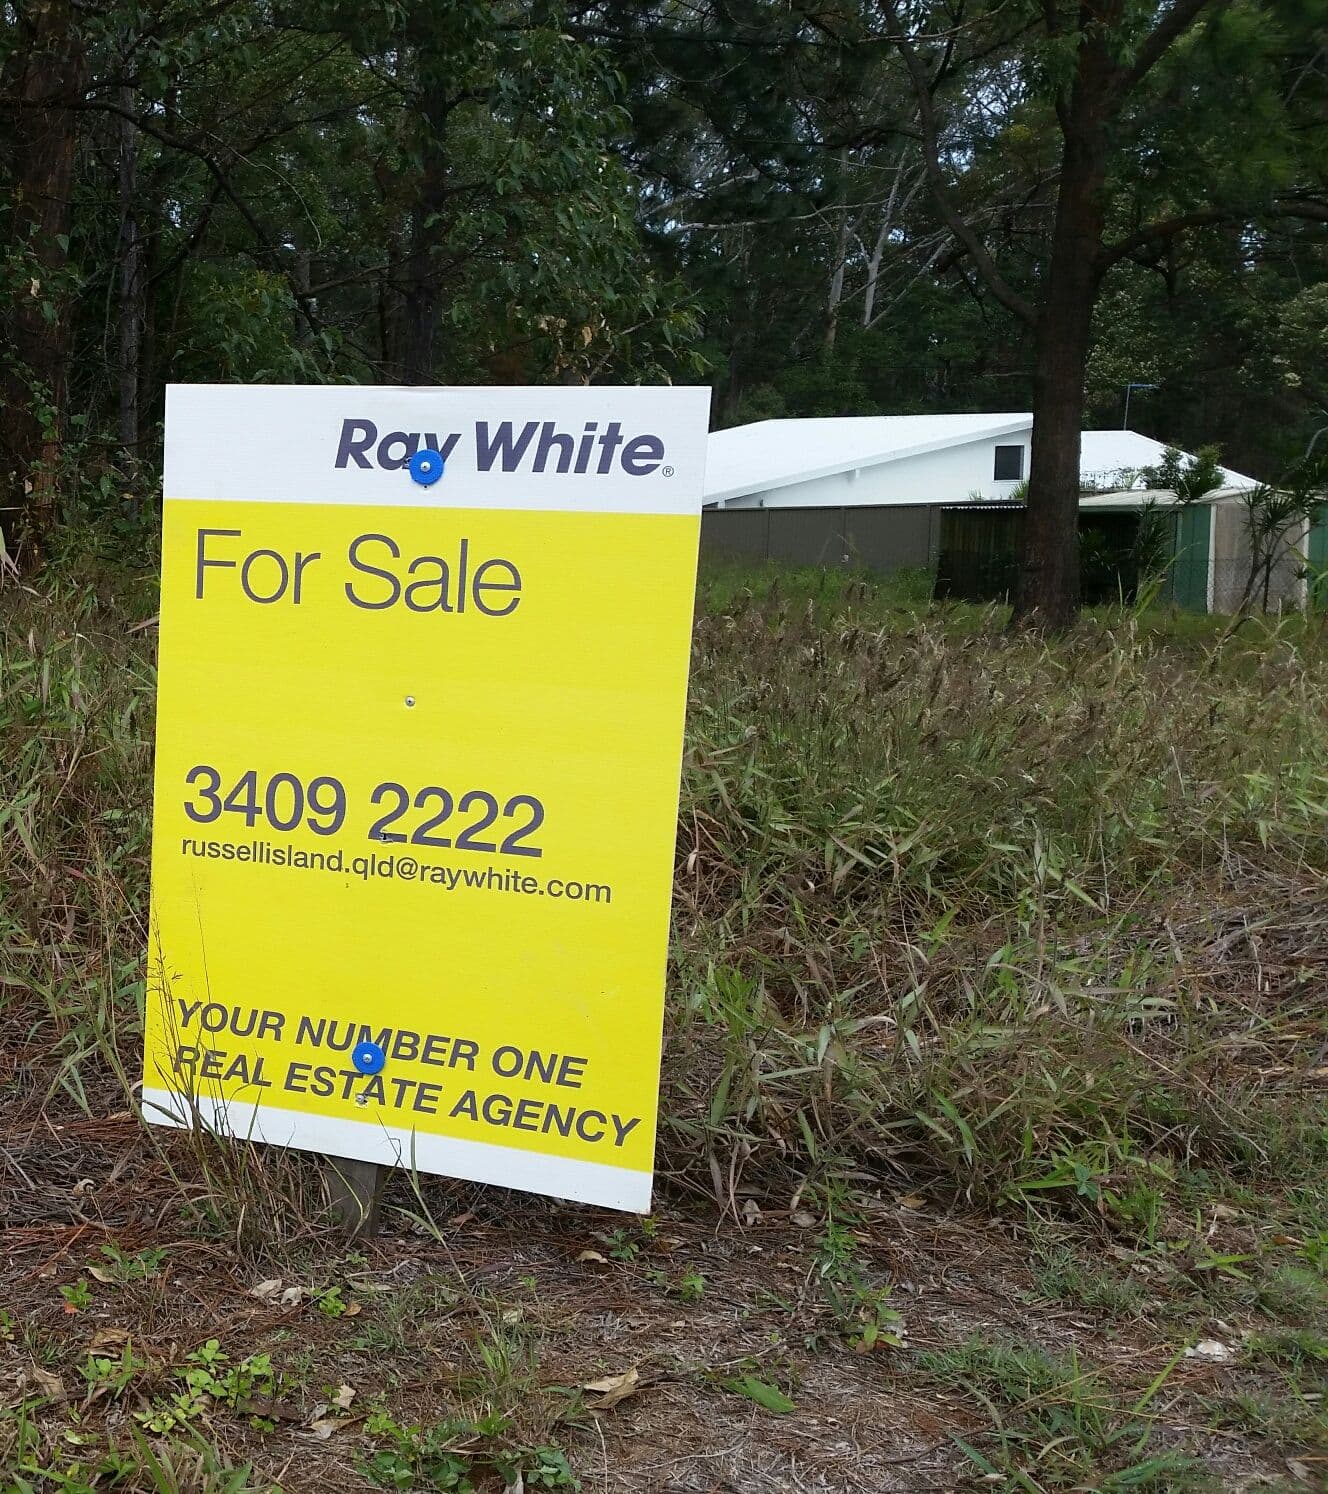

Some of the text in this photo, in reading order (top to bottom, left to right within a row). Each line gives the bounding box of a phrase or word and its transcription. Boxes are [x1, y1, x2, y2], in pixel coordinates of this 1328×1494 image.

[194, 528, 522, 617] For Sale
[183, 765, 545, 859] 3409 2222
[181, 834, 612, 904] russellisland.qld@raywhite.com
[177, 998, 286, 1042] YOUR
[490, 1045, 589, 1089] ONE
[172, 1044, 642, 1148] REAL ESTATE AGENCY
